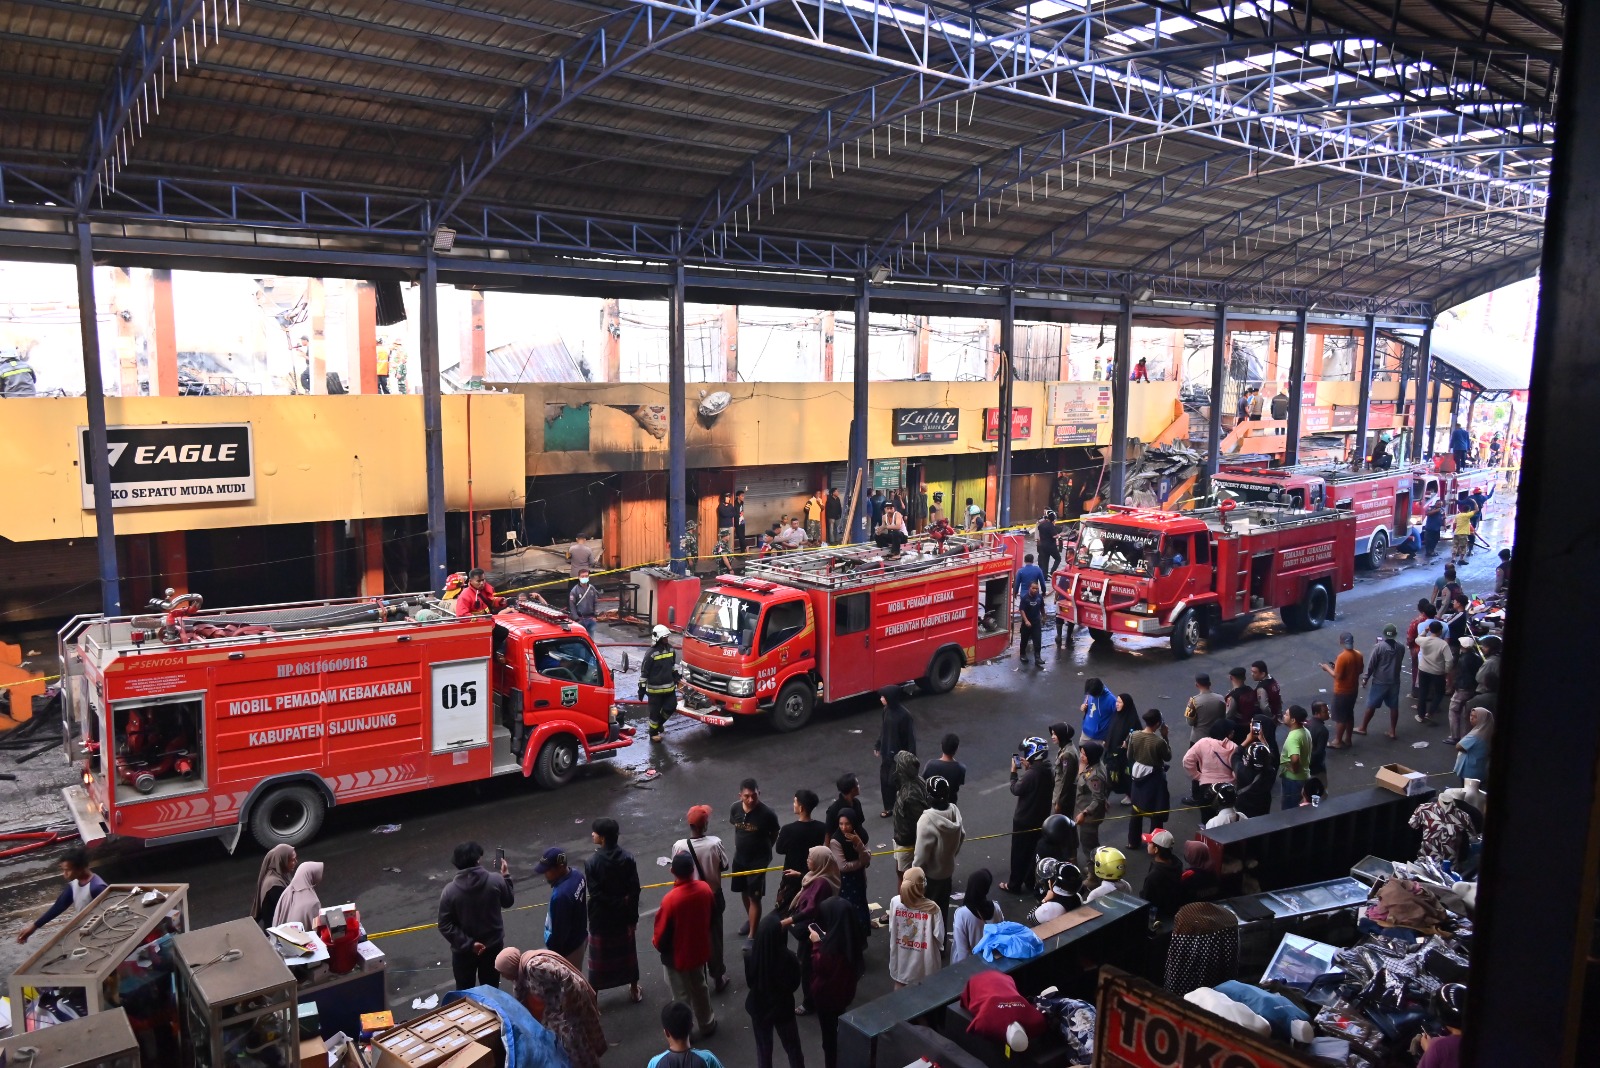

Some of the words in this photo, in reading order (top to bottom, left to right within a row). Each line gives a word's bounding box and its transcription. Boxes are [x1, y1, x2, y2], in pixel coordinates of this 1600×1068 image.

[134, 443, 239, 465] EAGLE
[132, 486, 177, 499] SEPATU
[181, 484, 213, 496] MUDA
[216, 483, 246, 494] MUDI
[1160, 482, 1168, 499] P
[1100, 531, 1122, 541] PADANG
[1123, 534, 1153, 546] PANJANG
[888, 602, 904, 613] MOBIL
[906, 594, 932, 609] PEMADAM
[933, 590, 954, 604] KEBAKA
[885, 620, 919, 636] PEMERINTAH
[921, 613, 951, 628] KABUPATEN
[951, 609, 966, 620] AGAM
[140, 656, 184, 669] SENTOSA
[277, 655, 368, 678] HP.08116609113
[757, 667, 777, 679] AGAM
[441, 680, 477, 710] 05
[756, 677, 777, 692] 06
[229, 700, 272, 716] MOBIL
[276, 689, 337, 710] PEMADAM
[339, 680, 412, 702] KEBAKARAN
[249, 723, 325, 747] KABUPATEN
[328, 713, 397, 735] SIJUNJUNG
